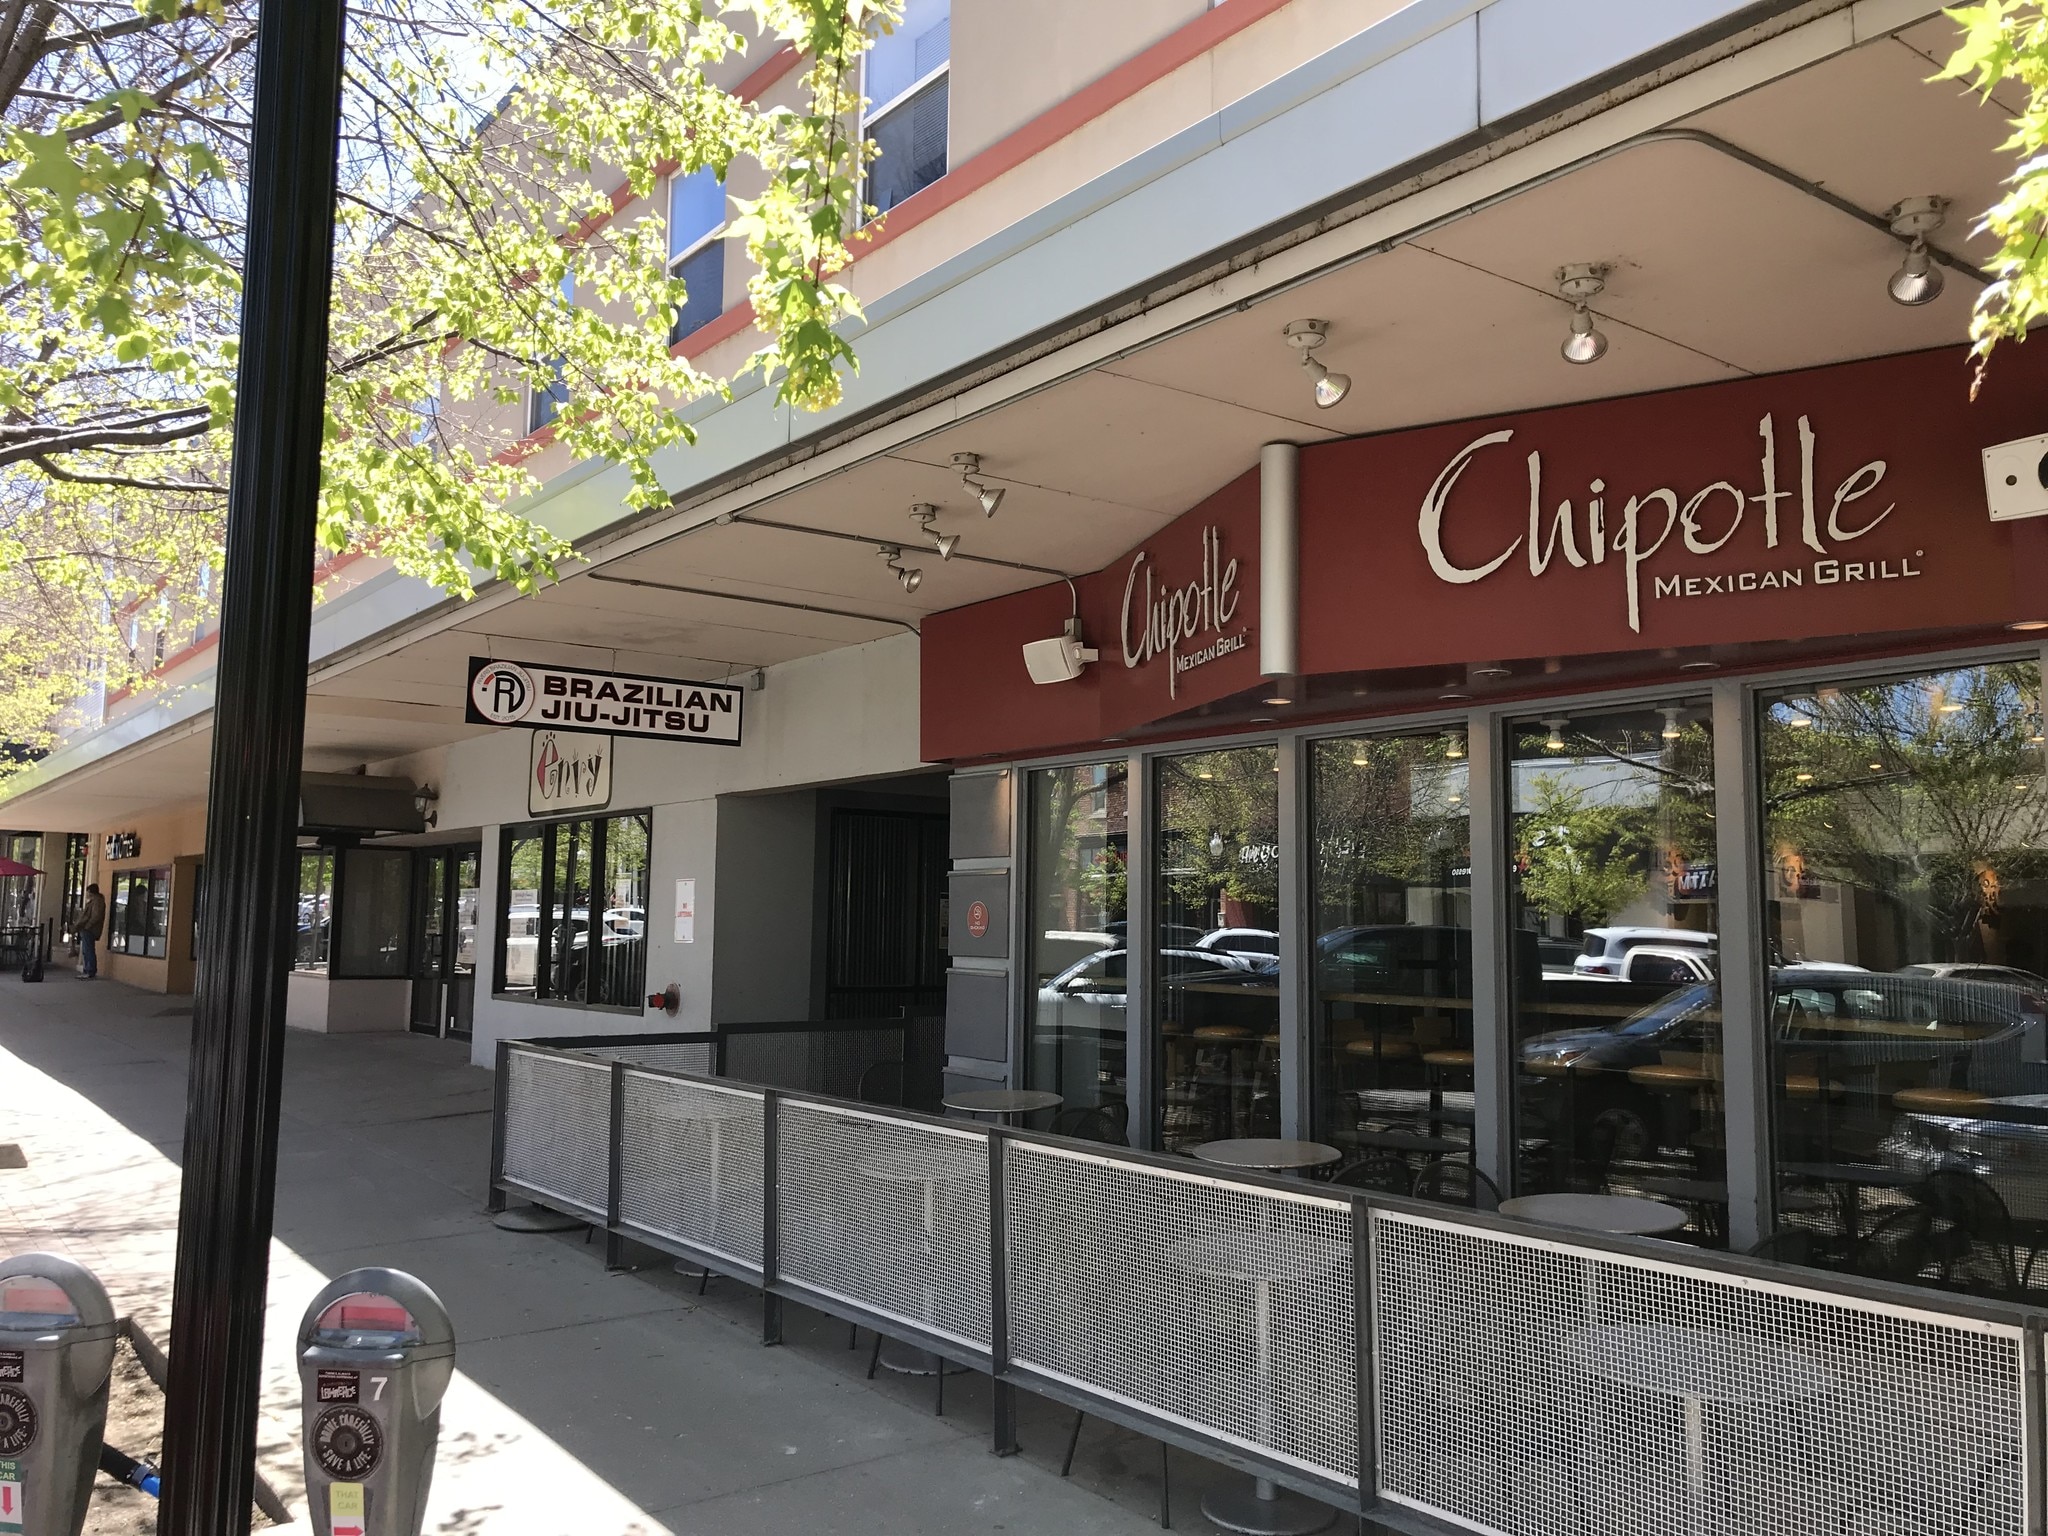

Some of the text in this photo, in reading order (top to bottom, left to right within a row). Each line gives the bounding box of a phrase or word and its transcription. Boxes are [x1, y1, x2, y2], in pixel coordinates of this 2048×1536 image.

[1418, 411, 1896, 634] Chipotle
[1654, 568, 1803, 599] MEXICAN
[1121, 525, 1240, 700] Chipotle
[1176, 645, 1216, 674] MEXICAN
[543, 674, 733, 713] BRAZILIAN
[541, 699, 710, 733] JIU-JITSU
[370, 1376, 388, 1401] 7
[339, 1413, 375, 1445] CAREFULLY
[0, 1460, 16, 1470] HIS
[322, 1449, 372, 1471] SAVE A LIFE
[336, 1490, 359, 1499] THAT
[337, 1502, 358, 1510] CAR
